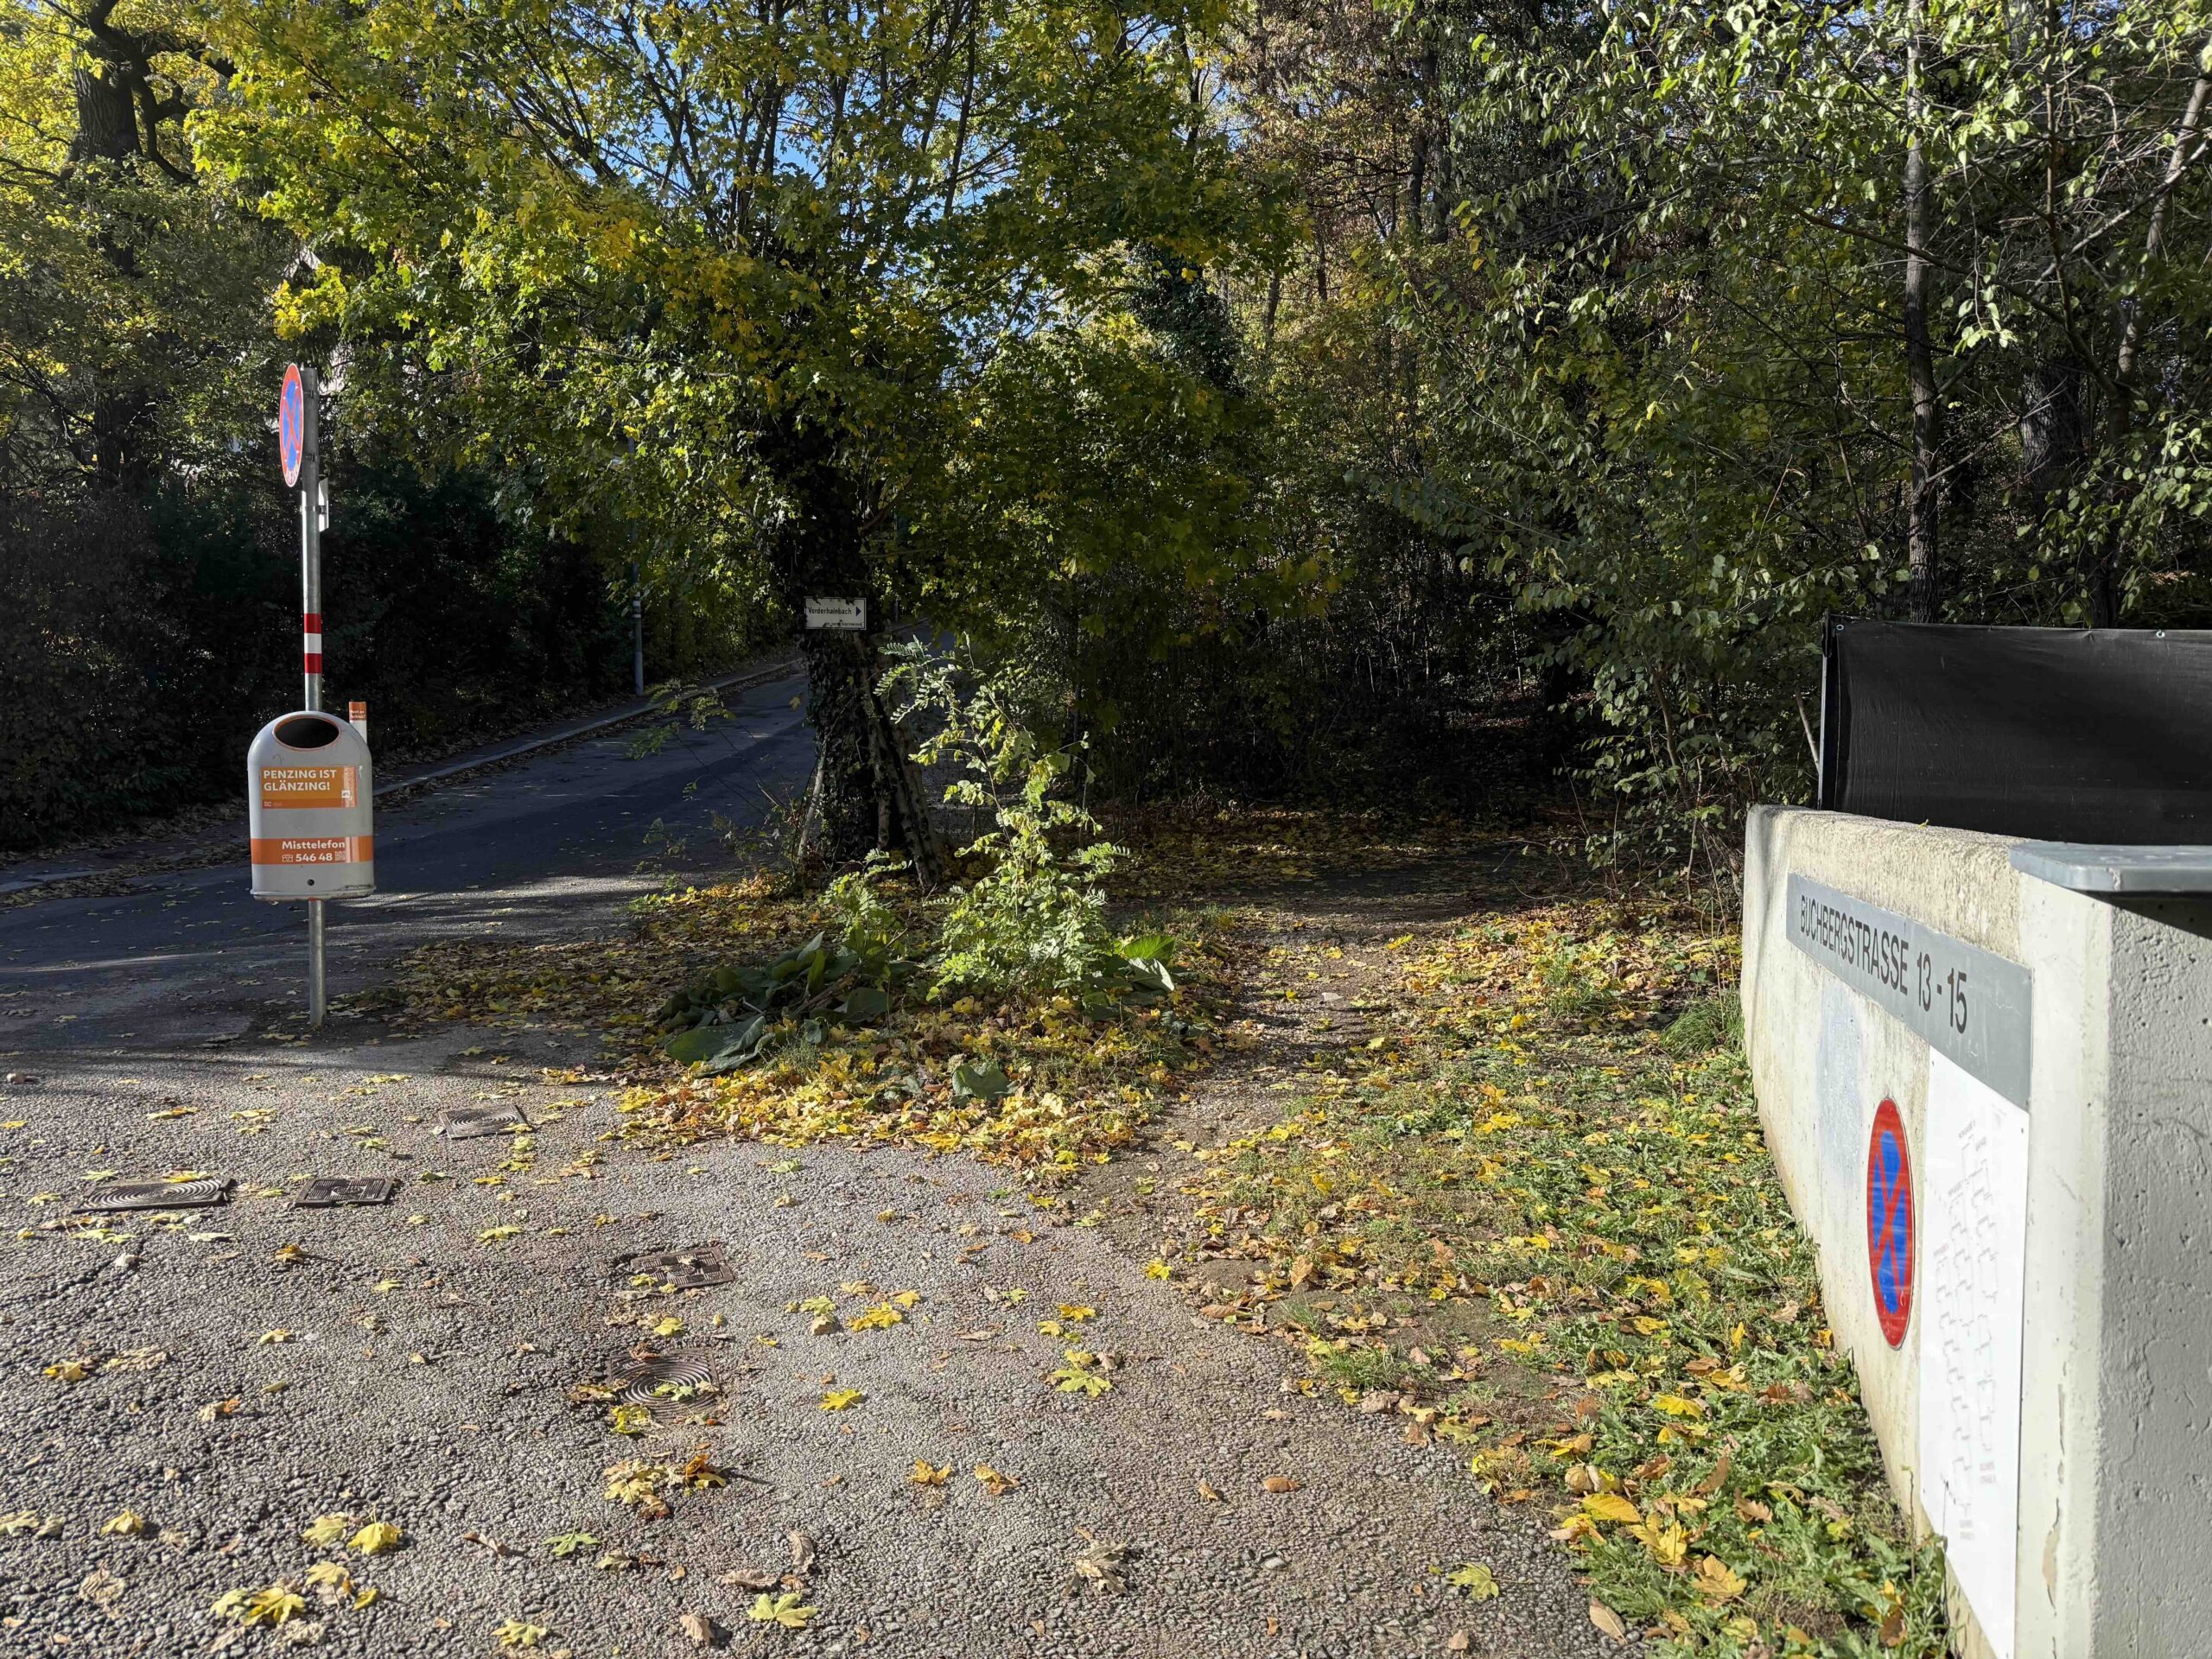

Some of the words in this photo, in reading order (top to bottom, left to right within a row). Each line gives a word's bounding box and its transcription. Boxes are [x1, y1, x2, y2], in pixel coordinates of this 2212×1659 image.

[264, 770, 316, 779] PENZING
[320, 770, 337, 779] IST
[264, 779, 330, 791] GLÄNZING!
[282, 840, 346, 850] Misttelefon
[296, 853, 317, 862] 546
[318, 852, 334, 861] 48
[1800, 894, 1910, 996] BUCHBERGSTRASSE
[1916, 951, 1932, 1013] 13
[1947, 967, 1967, 1034] 15
